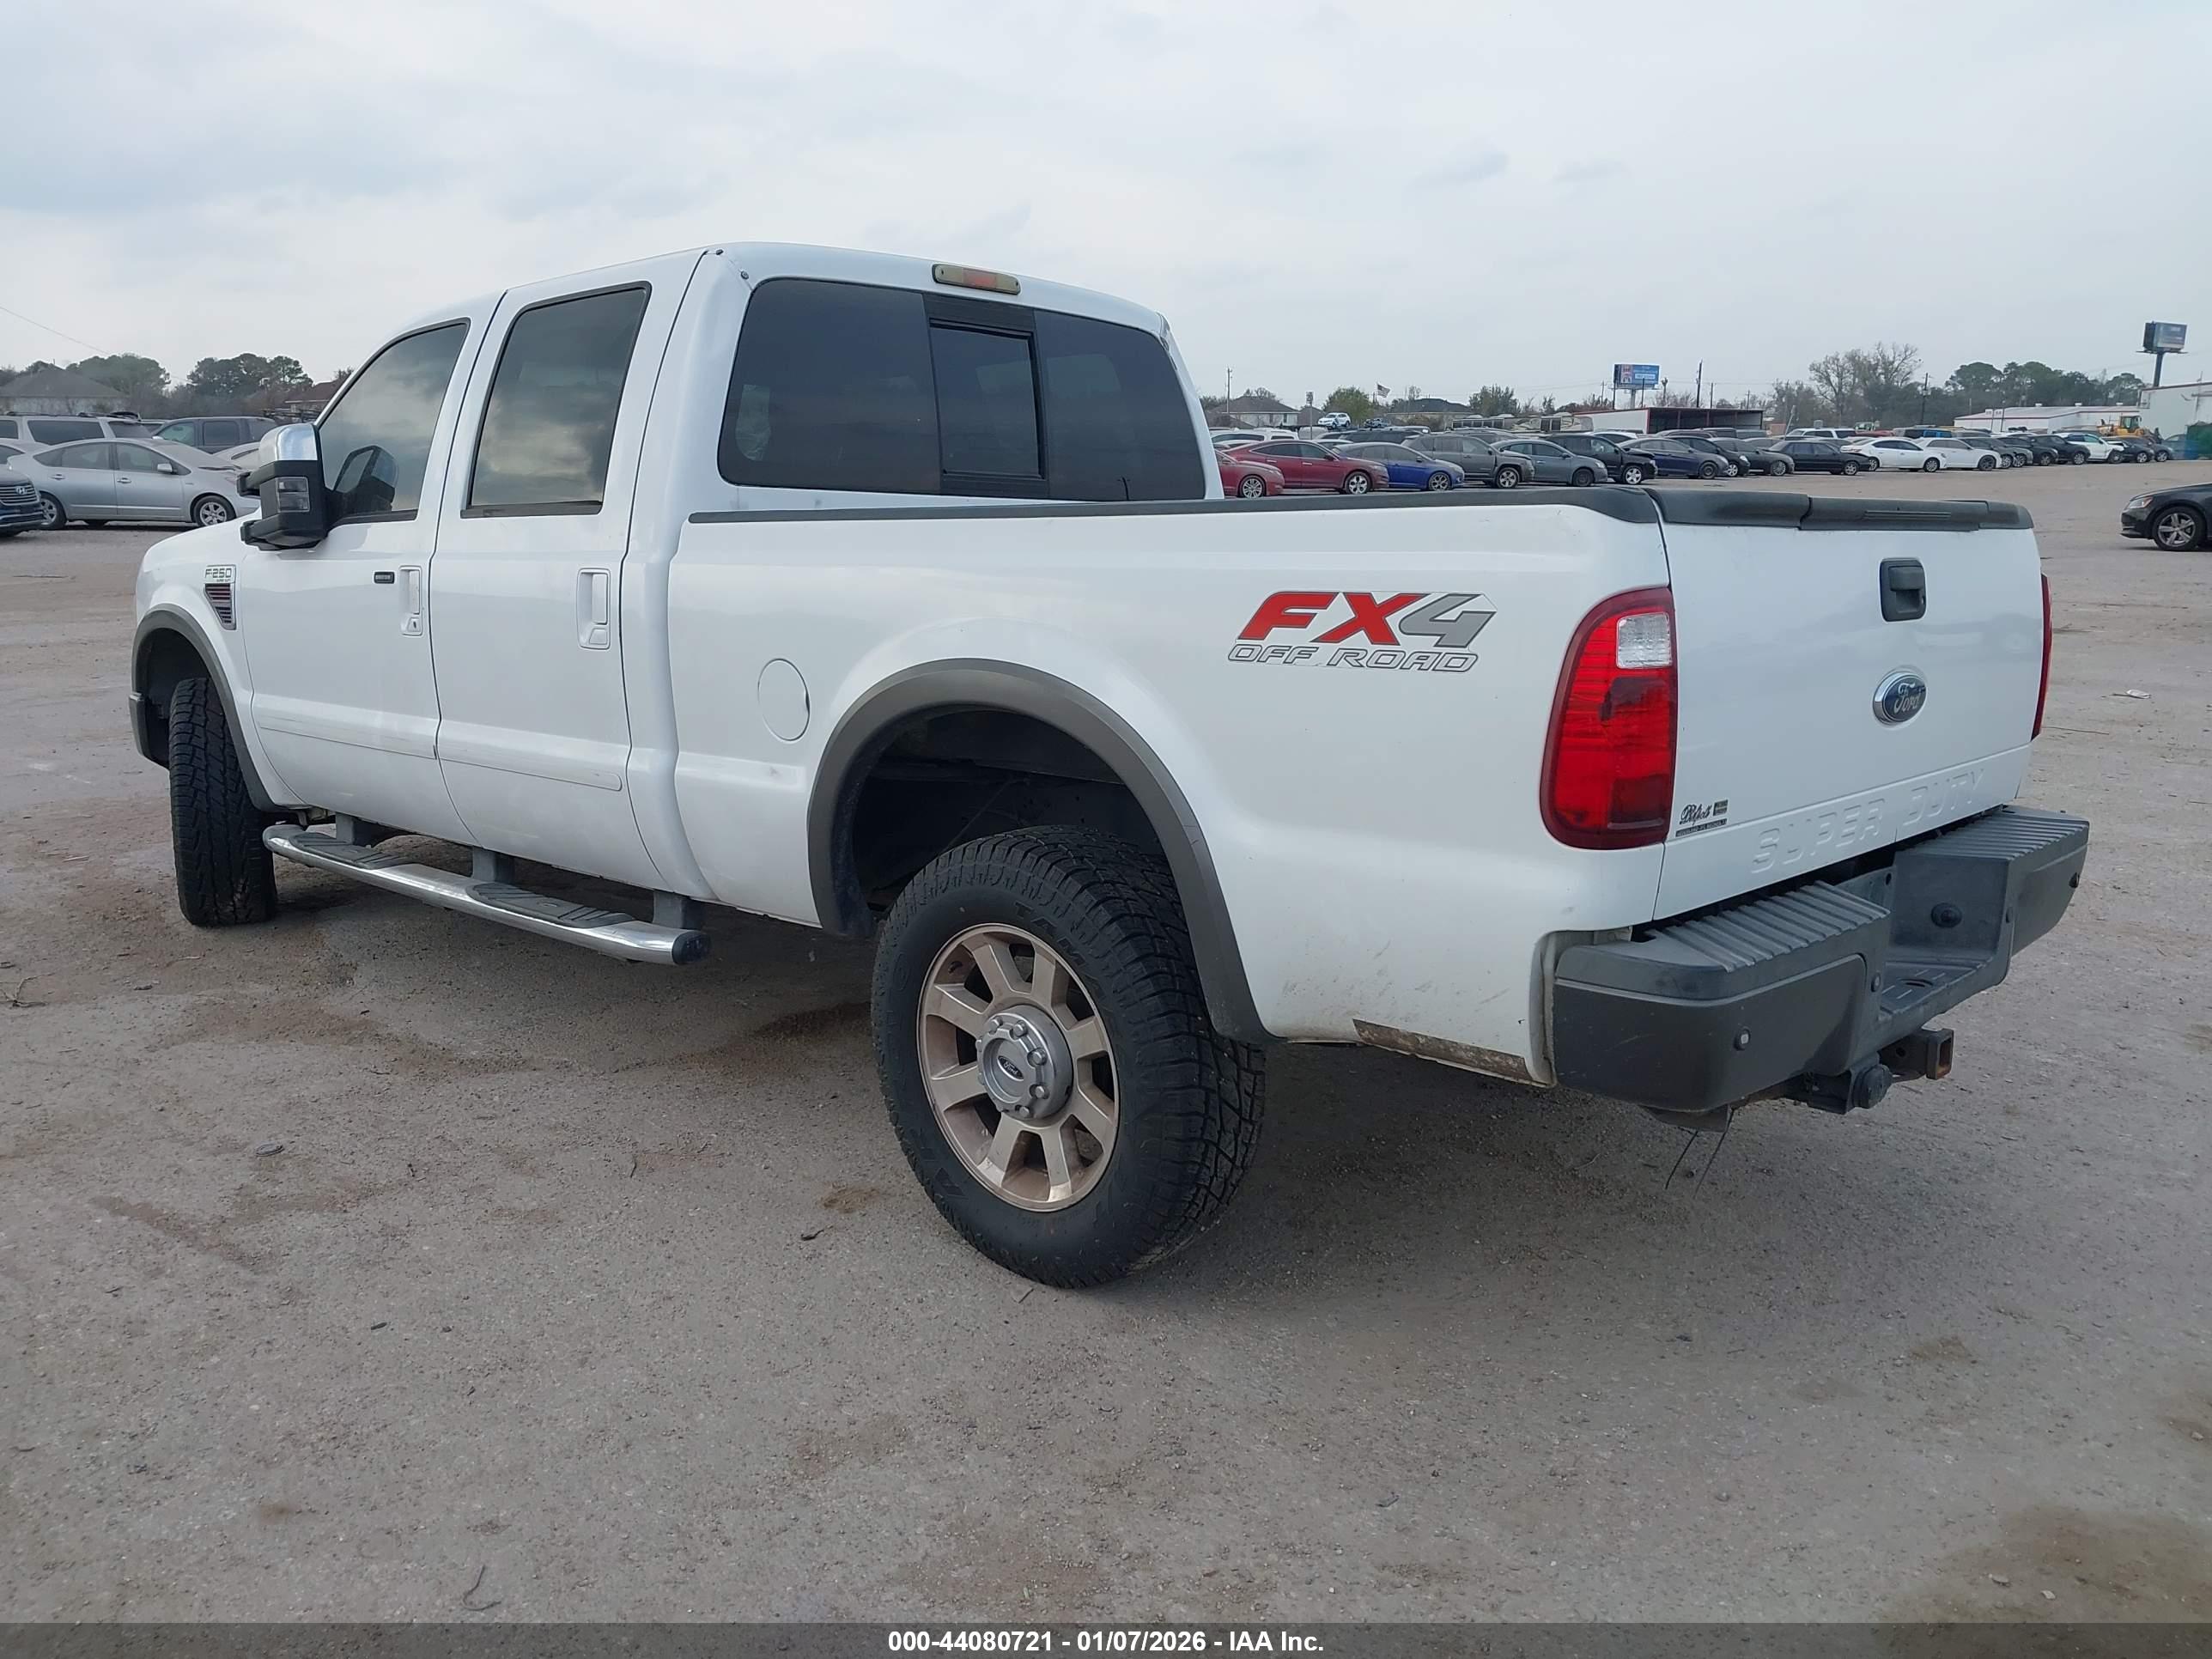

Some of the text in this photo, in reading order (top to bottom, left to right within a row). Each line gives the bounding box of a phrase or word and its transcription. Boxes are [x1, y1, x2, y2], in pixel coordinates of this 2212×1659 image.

[204, 568, 232, 579] F-250
[1237, 591, 1498, 648] FX4
[1228, 643, 1480, 673] OFF ROAD
[1750, 768, 1985, 874] SUPER DUTY
